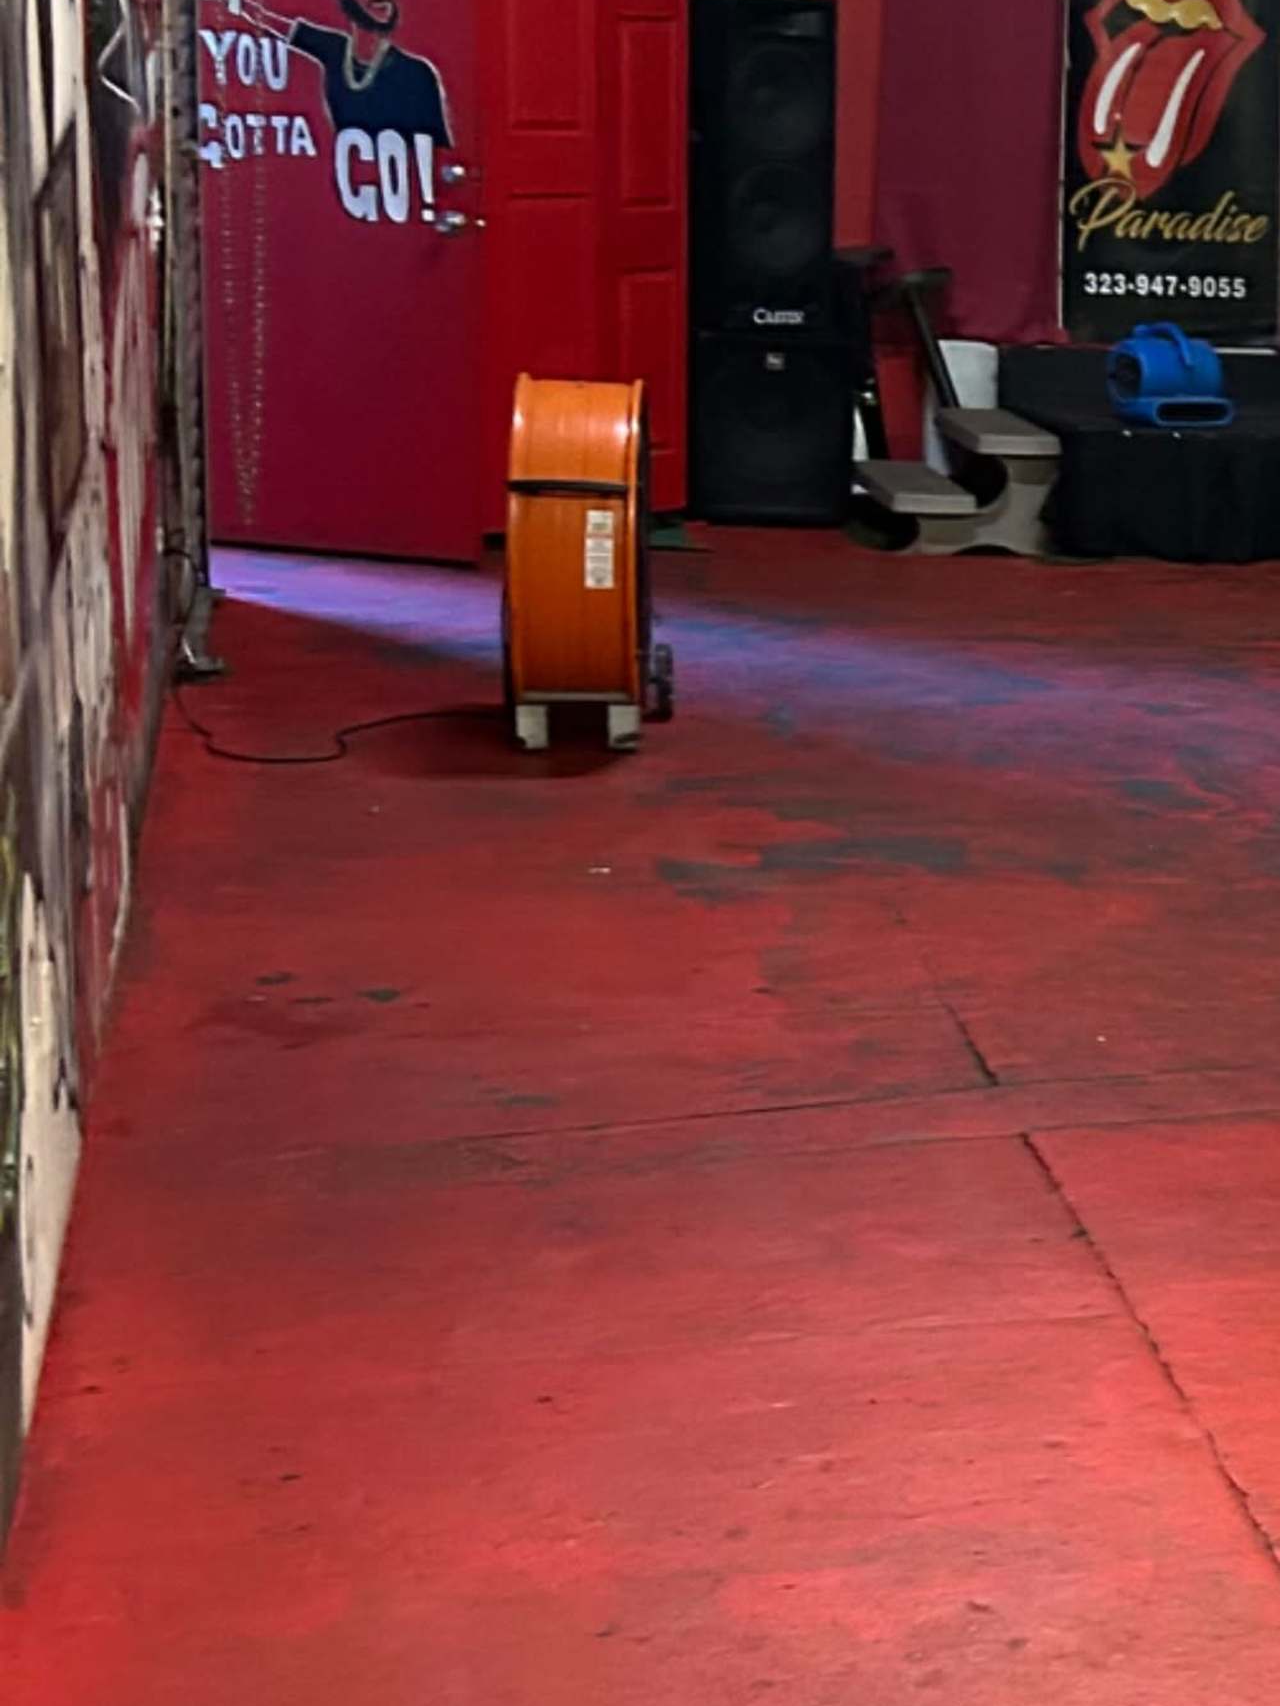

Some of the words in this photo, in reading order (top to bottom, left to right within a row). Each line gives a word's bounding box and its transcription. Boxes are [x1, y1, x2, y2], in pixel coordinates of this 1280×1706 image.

[198, 28, 288, 92] YOU
[198, 103, 318, 169] GOTTA
[334, 127, 437, 223] GO!
[1069, 177, 1269, 252] Paradise
[1083, 271, 1247, 299] 323-947-9055
